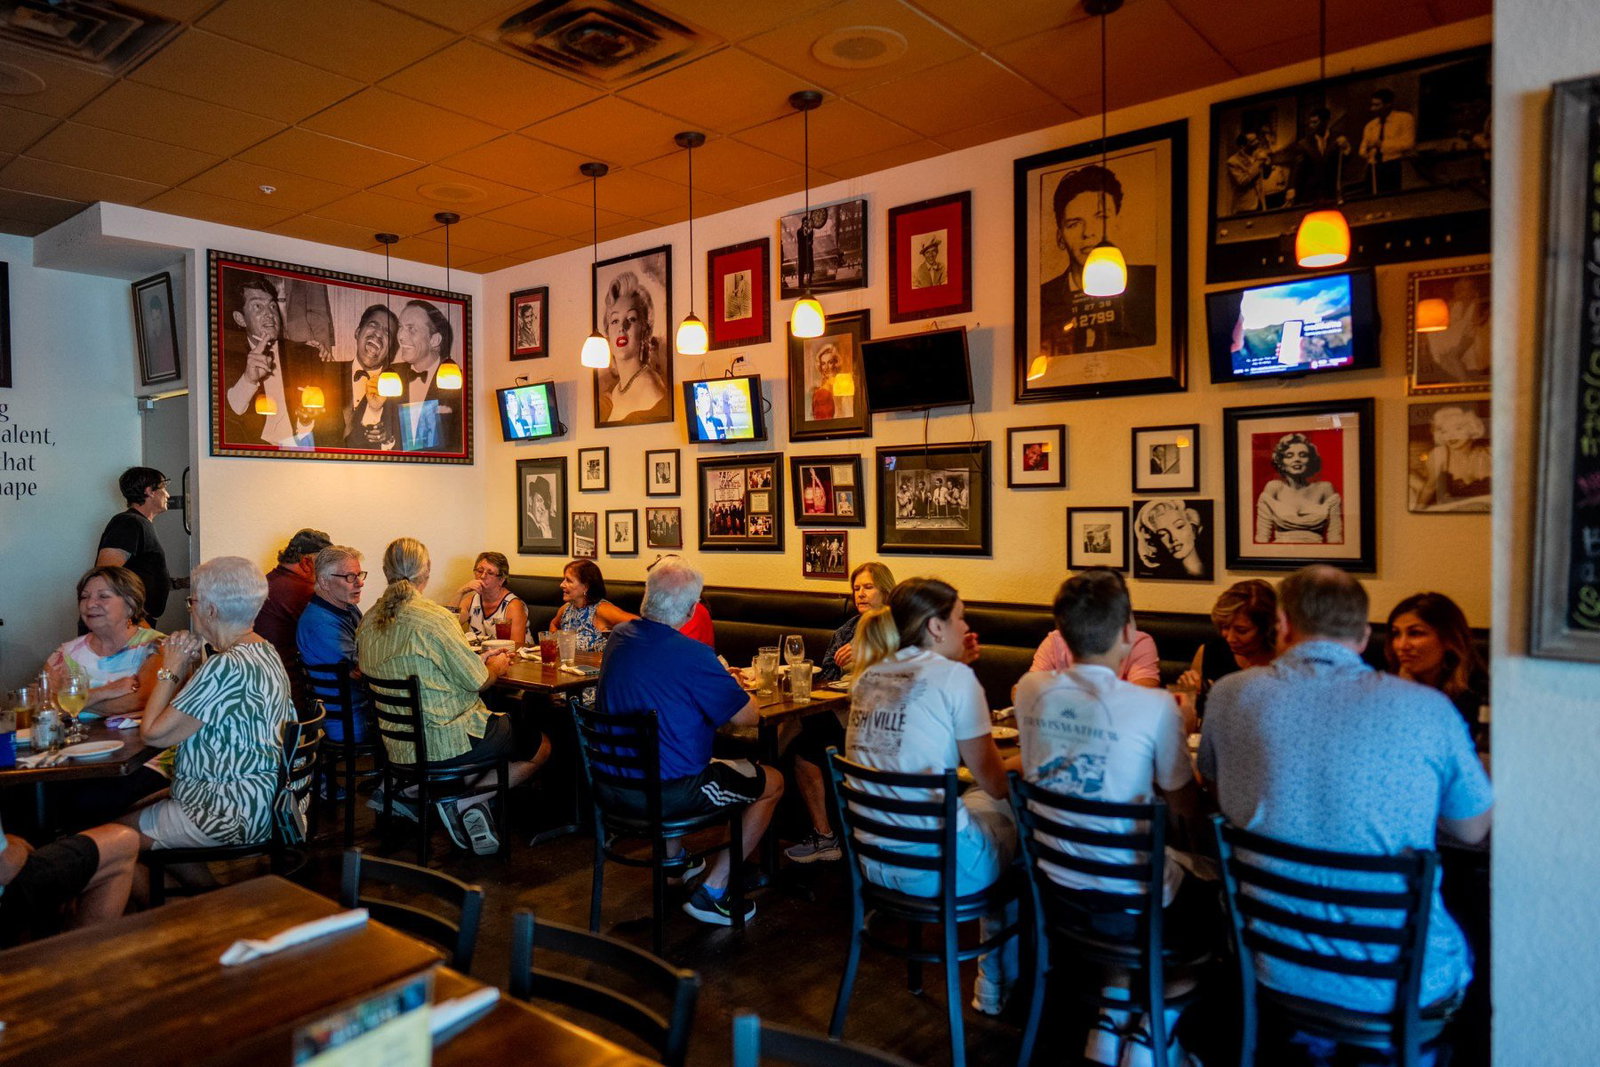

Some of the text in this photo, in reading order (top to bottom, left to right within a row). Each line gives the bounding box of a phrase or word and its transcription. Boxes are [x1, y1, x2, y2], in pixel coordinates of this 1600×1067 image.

[0, 424, 56, 446] alent,
[0, 451, 36, 471] hat
[0, 481, 37, 500] ape
